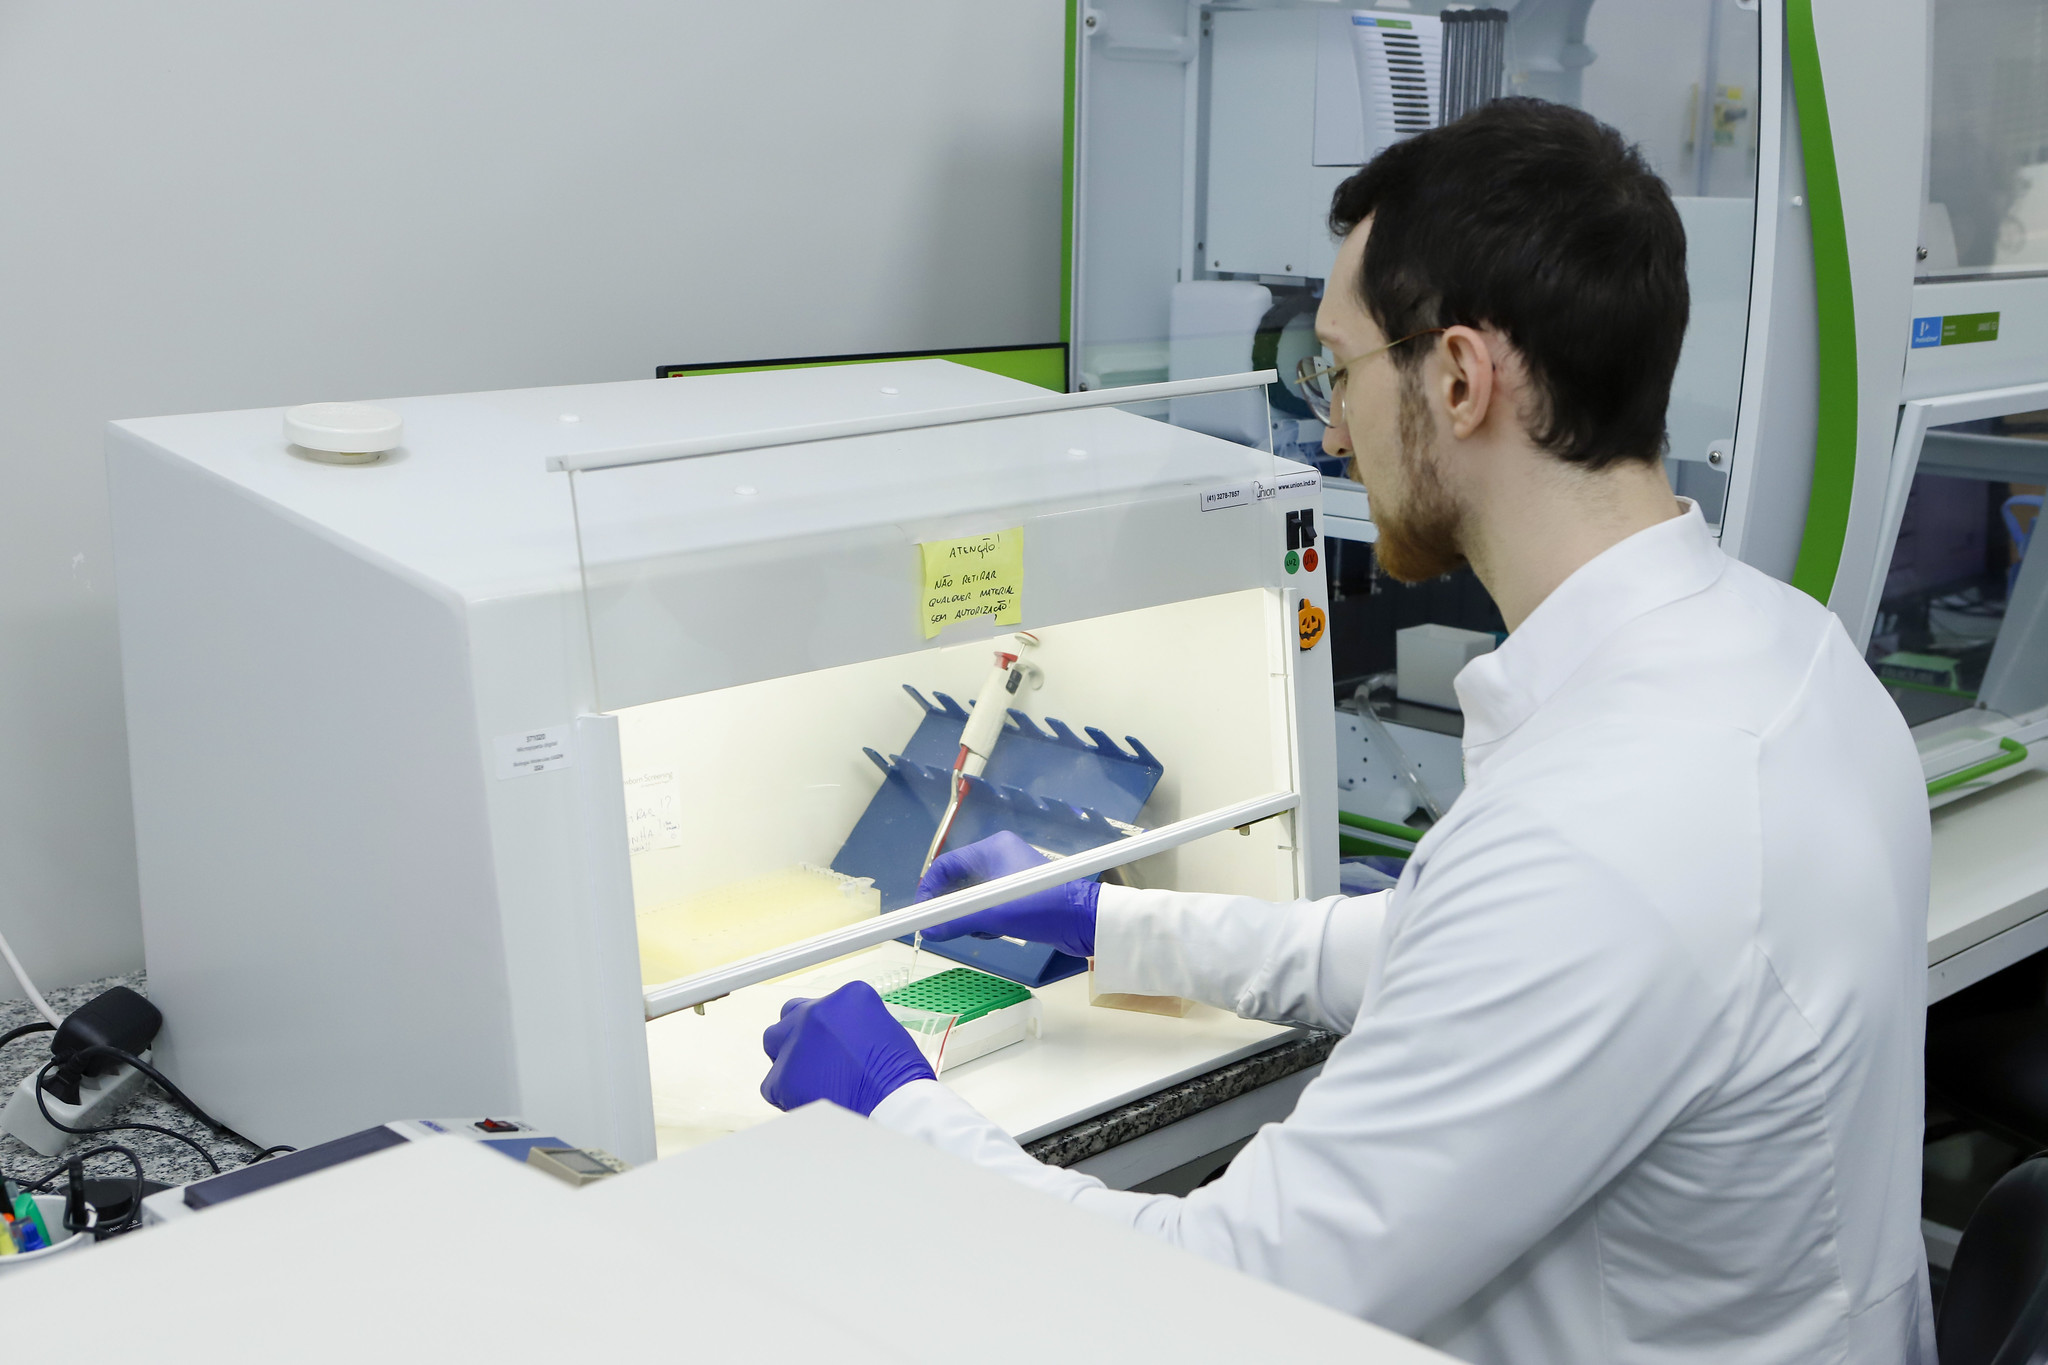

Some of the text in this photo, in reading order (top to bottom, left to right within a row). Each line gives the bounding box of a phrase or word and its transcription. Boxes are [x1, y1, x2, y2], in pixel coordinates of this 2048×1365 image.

[1278, 480, 1317, 491] www.union.ind.br
[934, 570, 997, 590] NÃO RETIRAR
[928, 585, 1015, 608] QUALQUER MATERIAL
[930, 614, 947, 625] SEM
